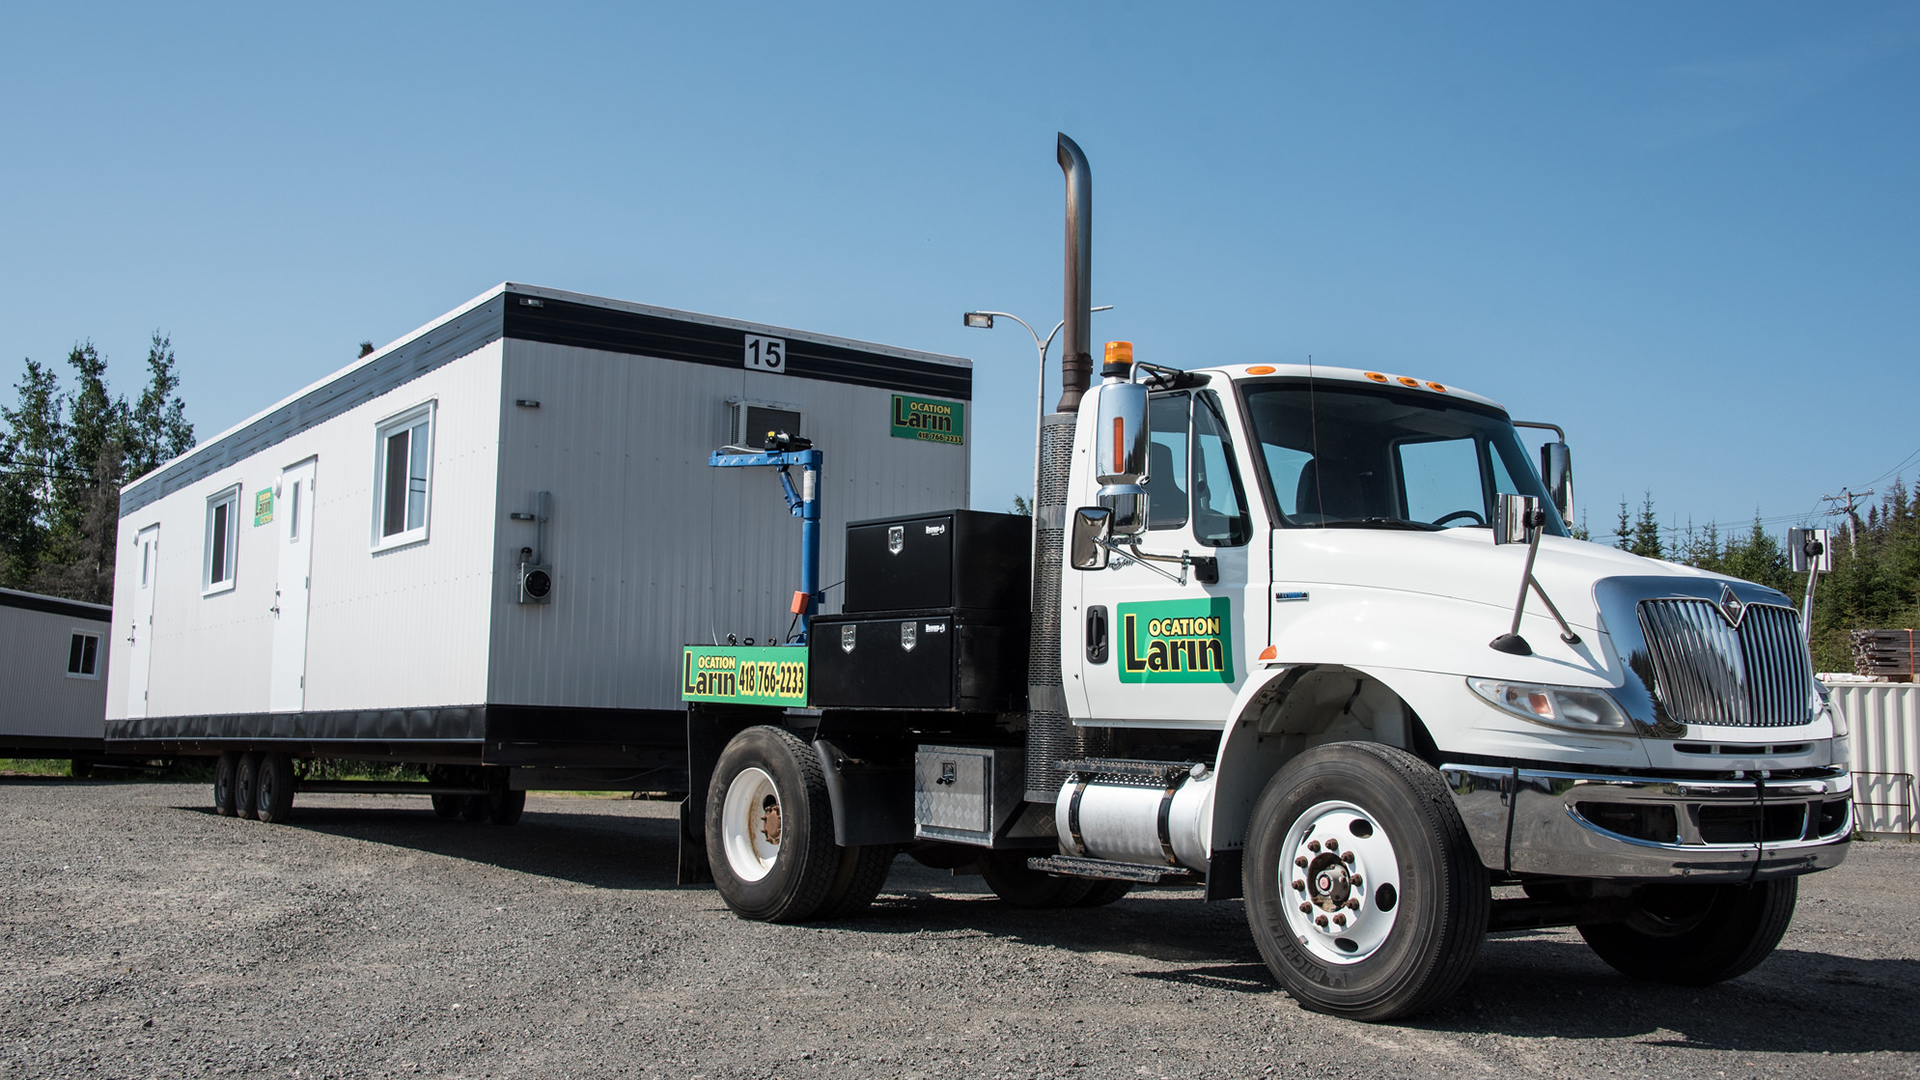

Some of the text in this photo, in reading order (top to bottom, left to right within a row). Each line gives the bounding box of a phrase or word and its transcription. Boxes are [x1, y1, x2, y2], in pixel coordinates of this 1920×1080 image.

[749, 339, 781, 368] 15
[894, 396, 952, 432] Larin
[910, 402, 951, 415] OCATION
[917, 431, 963, 445] 418 766-2233
[1148, 616, 1221, 637] OCATION
[1124, 613, 1225, 673] Larin
[683, 651, 806, 698] Larin 418 766-2233
[698, 655, 736, 670] OCATION
[1264, 901, 1326, 981] MICHELIN
